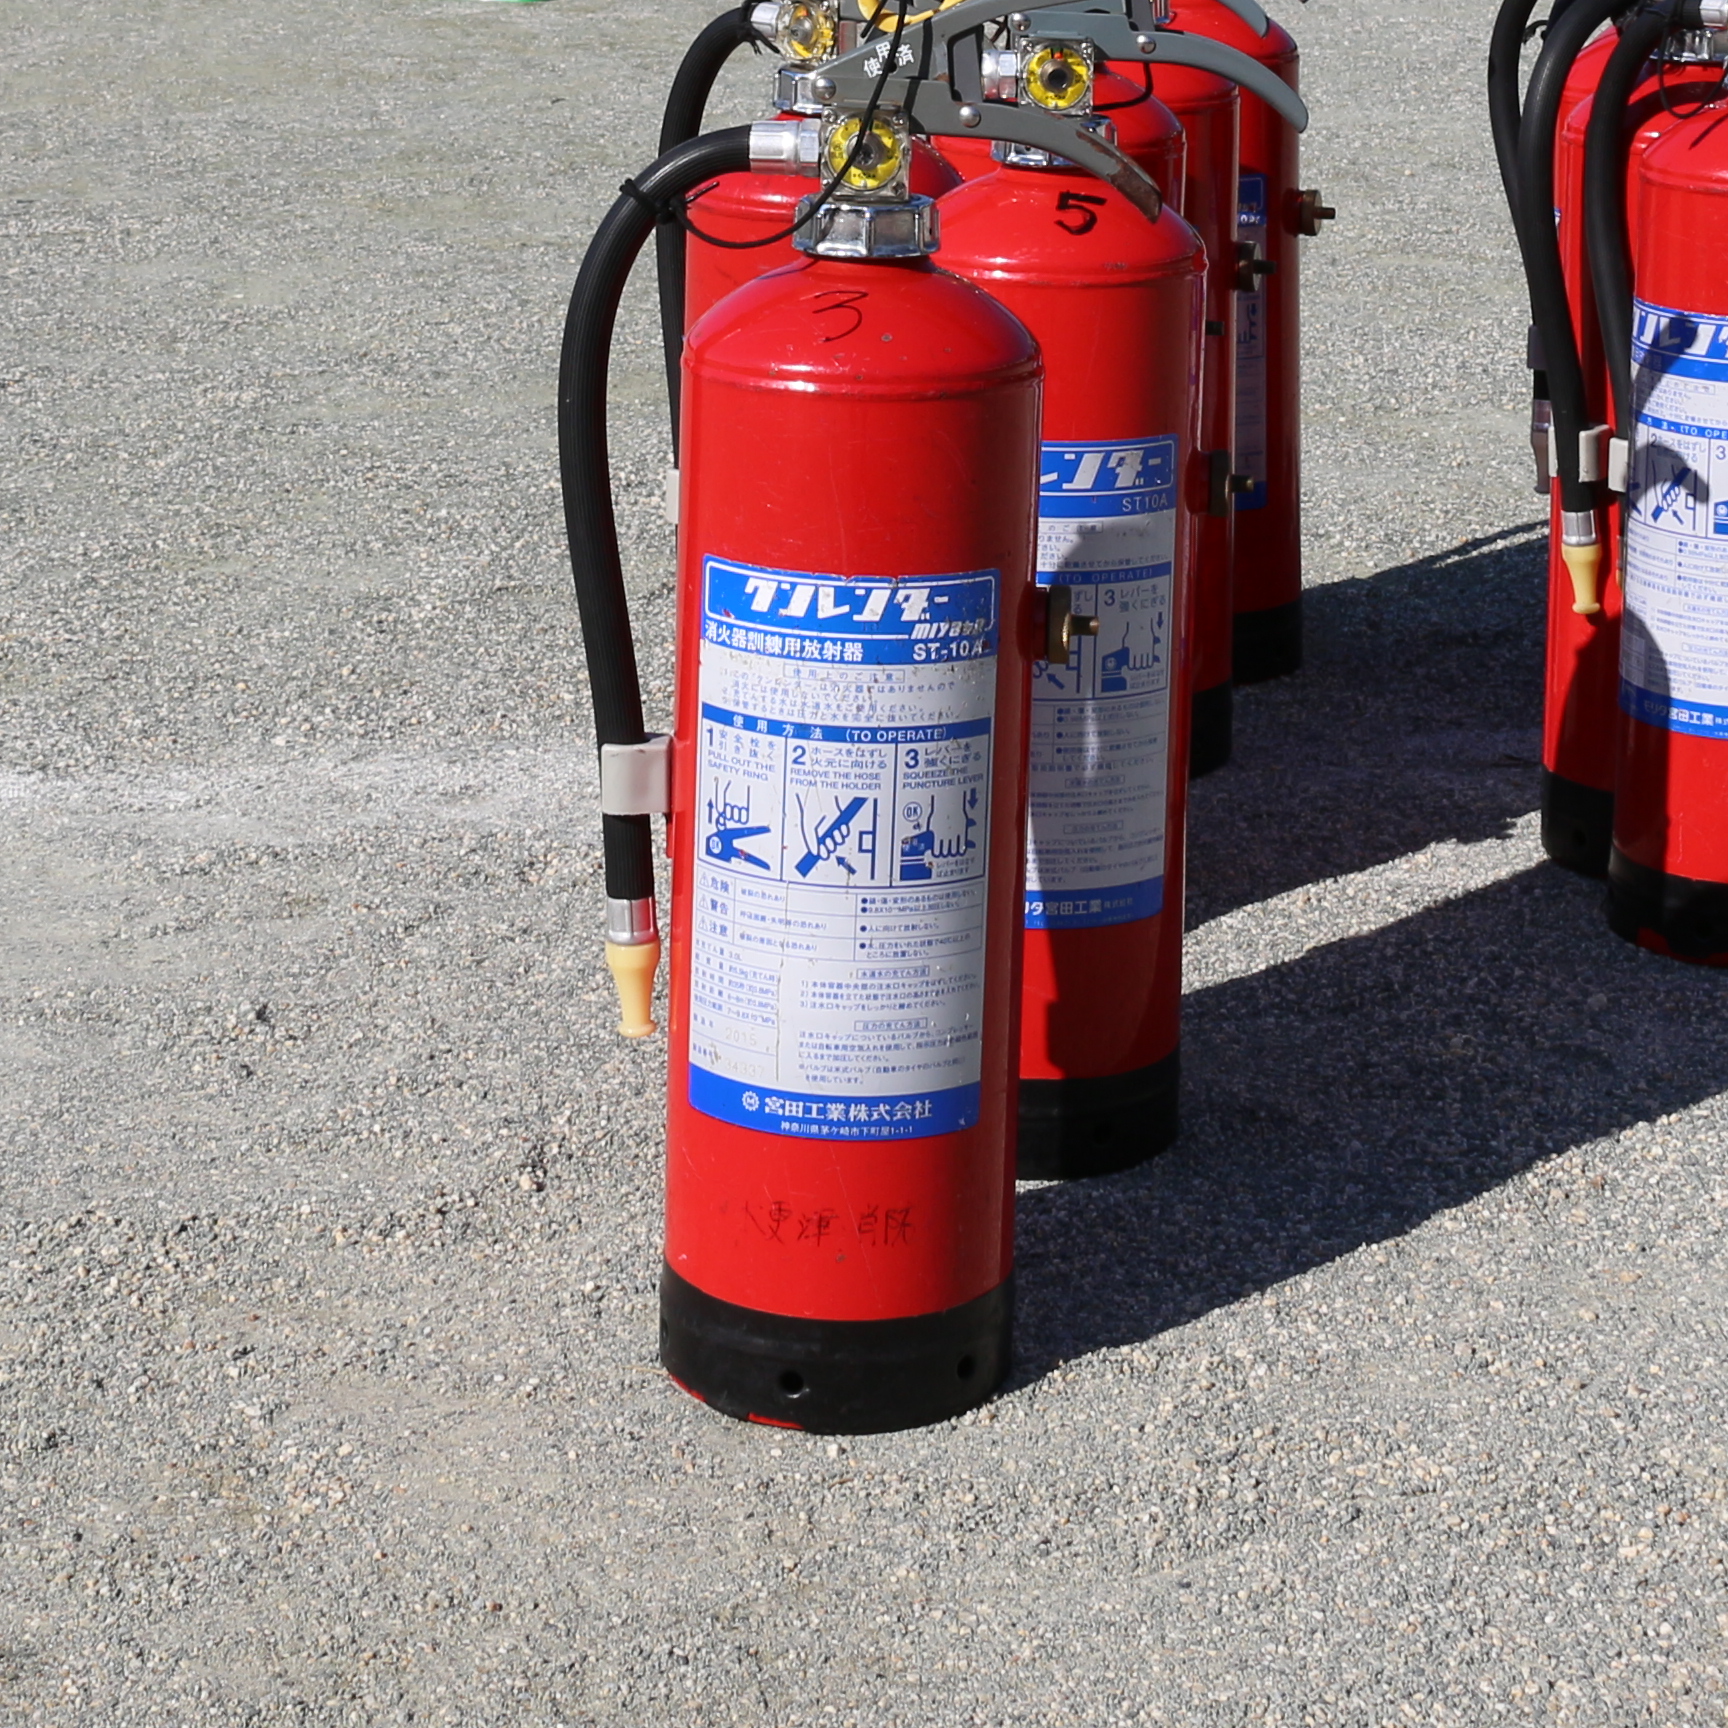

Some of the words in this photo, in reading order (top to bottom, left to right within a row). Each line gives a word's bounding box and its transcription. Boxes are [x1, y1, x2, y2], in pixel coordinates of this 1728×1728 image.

[1053, 192, 1106, 235] 5
[812, 290, 868, 342] 3
[1715, 445, 1726, 460] 3
[1122, 493, 1168, 512] ST10A
[744, 577, 949, 622] クンレンダー
[1104, 588, 1116, 607] 3
[705, 621, 864, 662] 消火器訓練用放射器
[706, 728, 714, 747] 1
[733, 714, 823, 740] 使用方法
[846, 728, 871, 742] (TO
[876, 727, 947, 742] OPERATE)
[707, 750, 729, 763] PULL
[731, 756, 753, 768] OUT
[755, 761, 776, 772] THE
[792, 745, 807, 766] 2
[811, 746, 887, 759] ホースをはずし
[811, 757, 887, 770] 火元に向ける
[904, 748, 920, 769] 3
[924, 751, 981, 768] 強くにぎる
[707, 759, 741, 775] SAFETY
[743, 769, 769, 782] RING
[790, 767, 826, 780] REMOVE
[830, 771, 852, 781] THE
[854, 772, 881, 781] HOSE
[903, 768, 950, 780] SQUEEZE
[790, 777, 817, 788] FROM
[821, 781, 839, 790] THE
[841, 781, 882, 791] HOLDER
[902, 777, 956, 790] PUNCTURE
[958, 773, 984, 785] LEVER
[905, 805, 920, 818] OK
[710, 838, 721, 850] OK
[710, 876, 729, 894] 危険
[710, 898, 729, 915] 警告
[709, 920, 728, 937] 注意
[765, 1096, 932, 1122] 宮田工業株式会社
